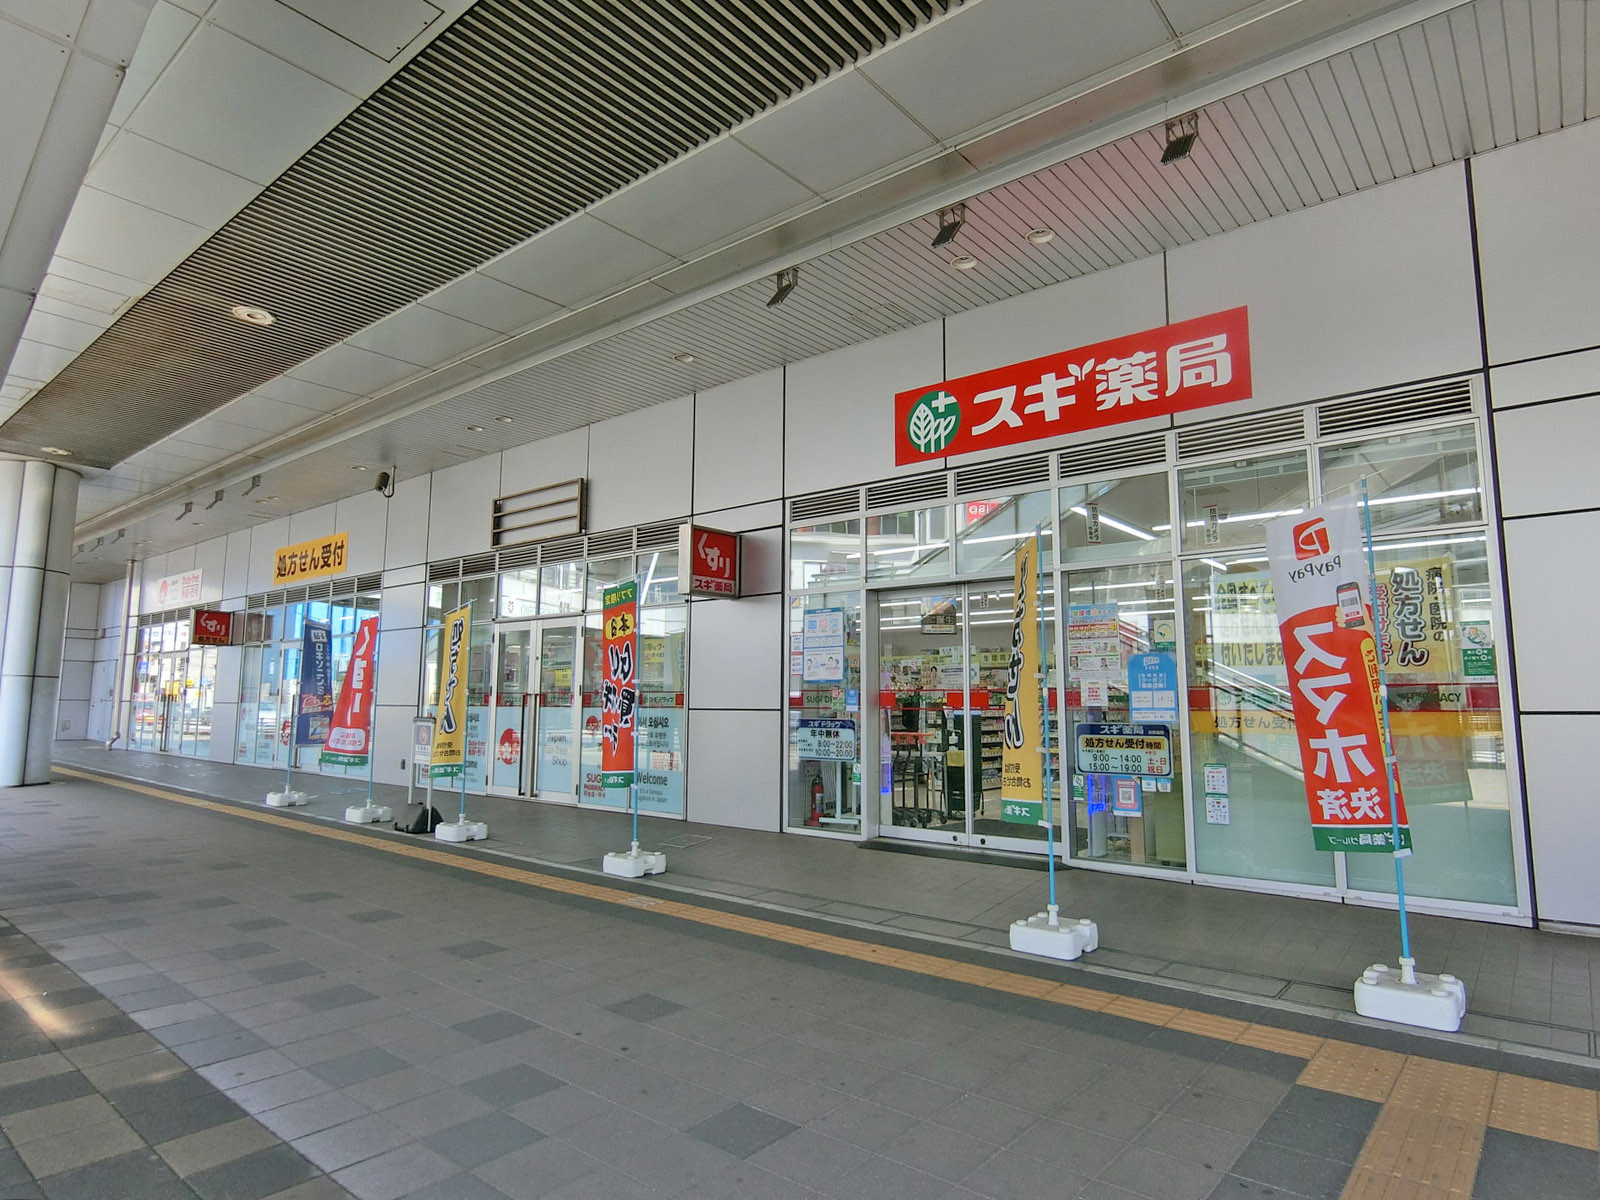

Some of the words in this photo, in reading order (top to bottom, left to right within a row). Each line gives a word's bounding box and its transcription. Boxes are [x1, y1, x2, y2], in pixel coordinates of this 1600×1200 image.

[972, 333, 1232, 436] スギ薬局
[276, 539, 345, 578] 処方せん受付
[698, 533, 730, 577] くすり
[694, 579, 733, 593] スギ薬局
[1390, 566, 1429, 667] 処方せん
[200, 613, 226, 635] くすり
[810, 730, 840, 738] 年中無休
[1100, 725, 1144, 735] スギ薬局
[1085, 737, 1161, 750] 処方せん受付時間
[552, 756, 567, 767] Shop
[586, 773, 603, 784] SUG
